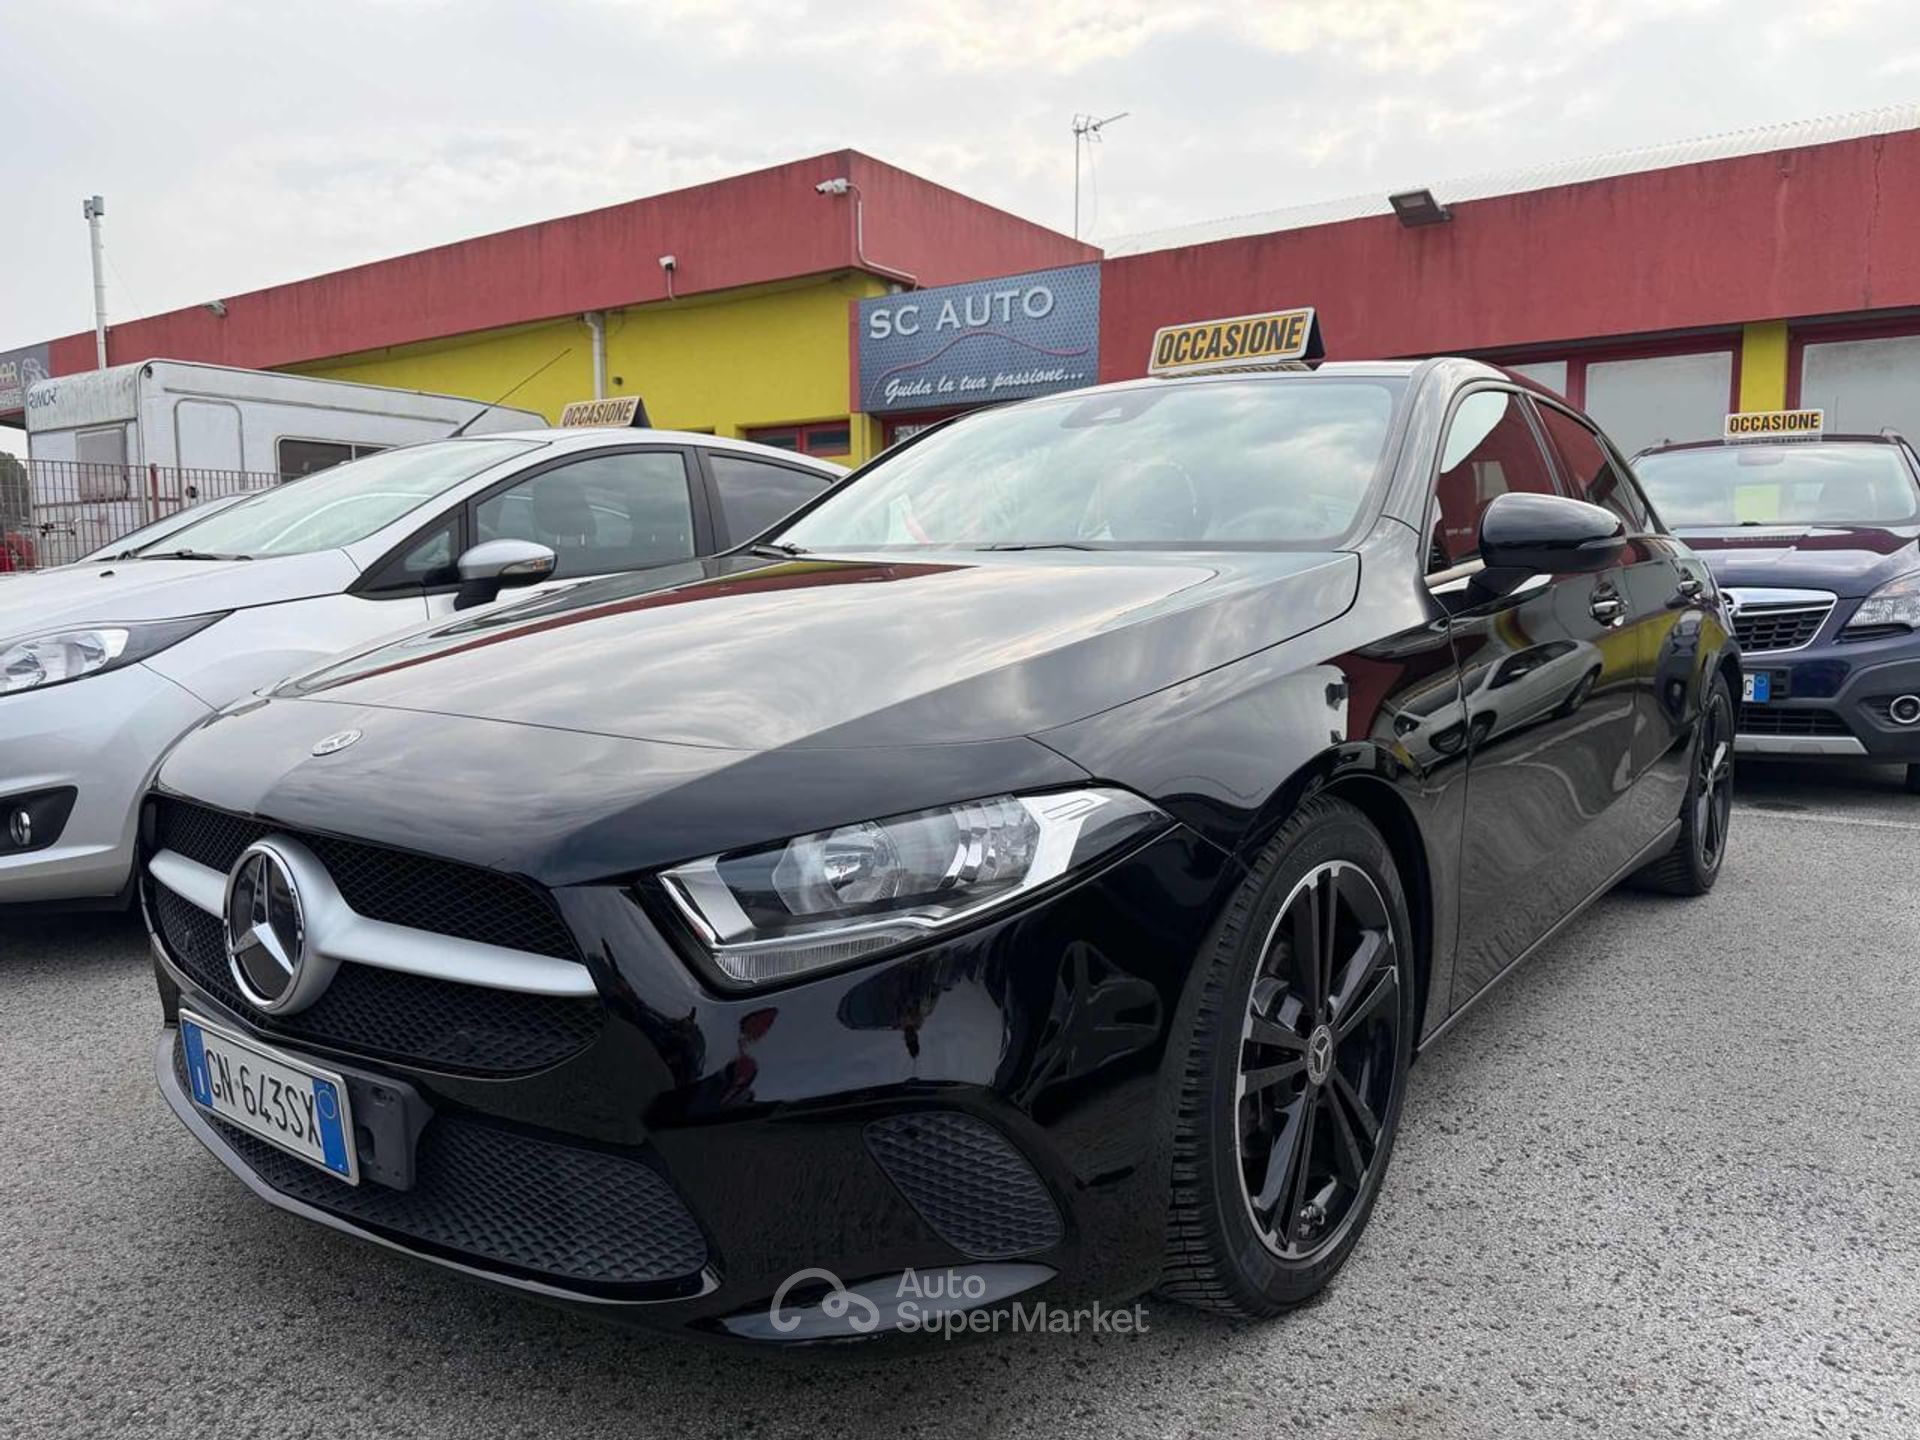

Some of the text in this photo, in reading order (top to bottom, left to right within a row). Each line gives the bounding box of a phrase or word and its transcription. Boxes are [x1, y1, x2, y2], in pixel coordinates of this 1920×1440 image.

[869, 285, 1055, 340] SC AUTO
[1156, 315, 1305, 366] OCCASIONE
[884, 378, 933, 405] Guida
[937, 374, 955, 394] la
[960, 374, 988, 391] tua
[562, 400, 634, 428] OCCASIONE
[1729, 412, 1820, 434] OCCASIONE
